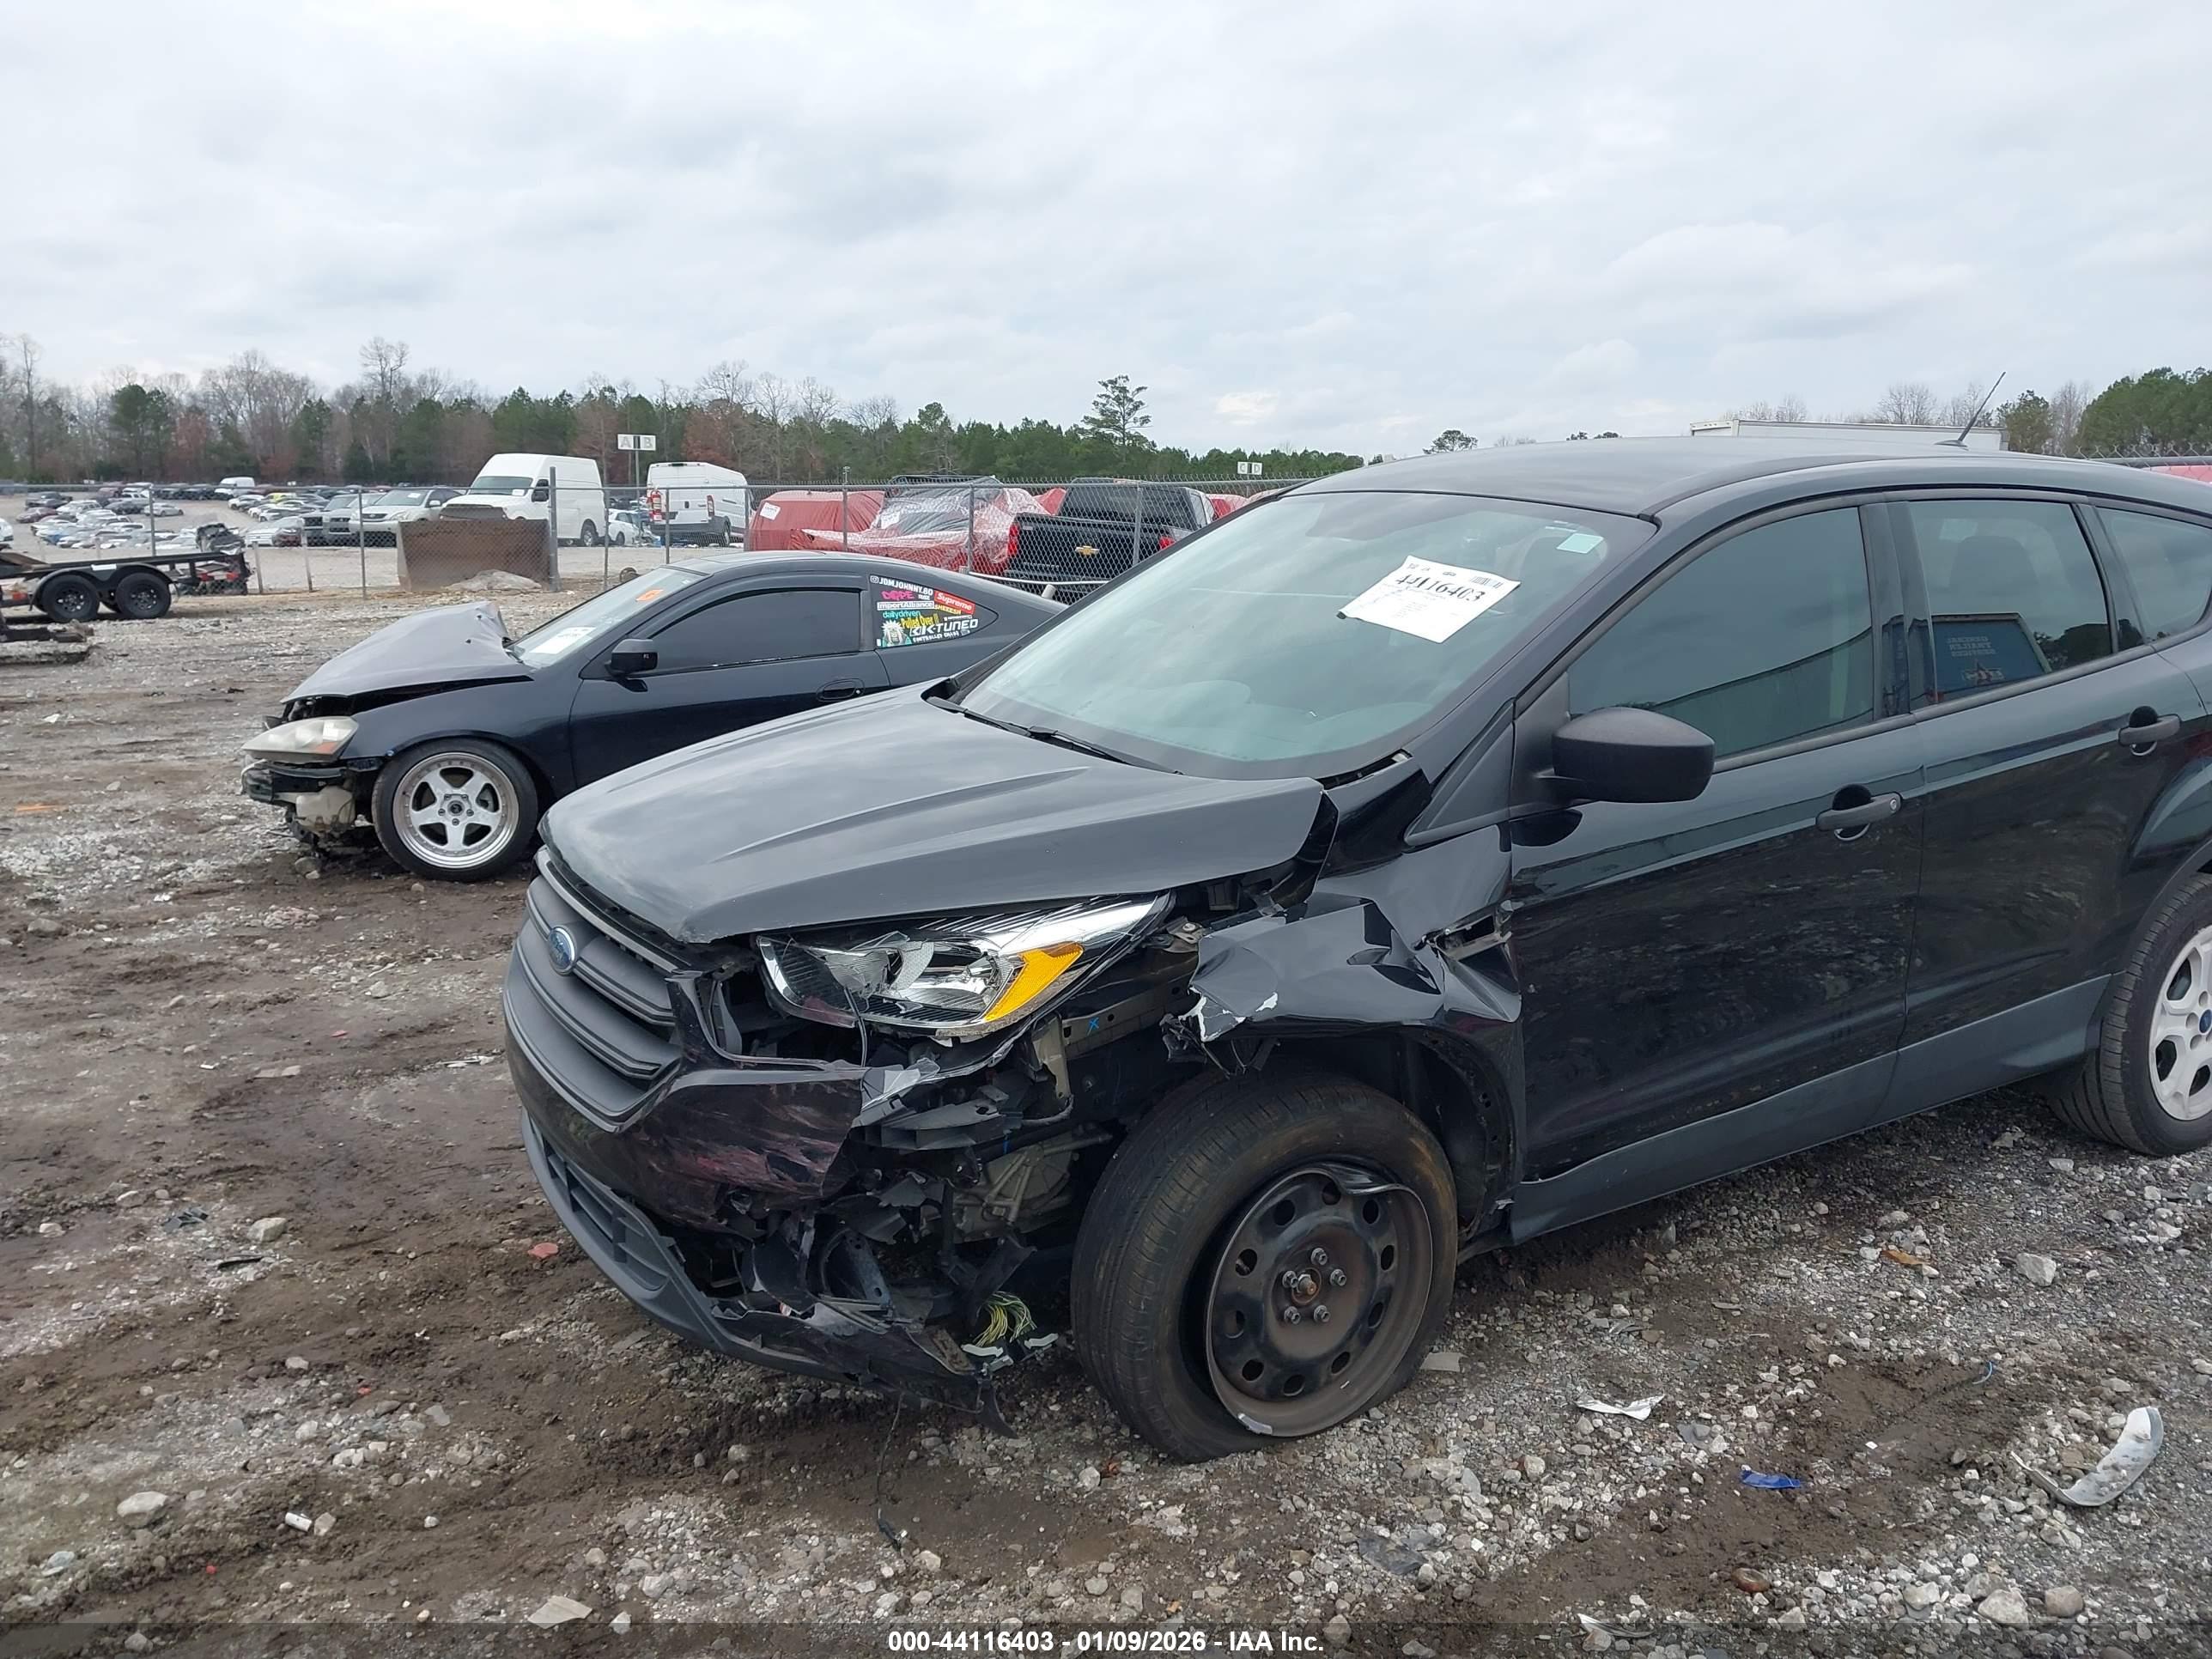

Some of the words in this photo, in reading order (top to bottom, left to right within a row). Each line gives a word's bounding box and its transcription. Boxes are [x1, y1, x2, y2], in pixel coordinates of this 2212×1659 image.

[620, 435, 632, 448] A
[643, 436, 653, 449] B
[1395, 574, 1486, 602] 44116403
[937, 592, 973, 611] Supreme
